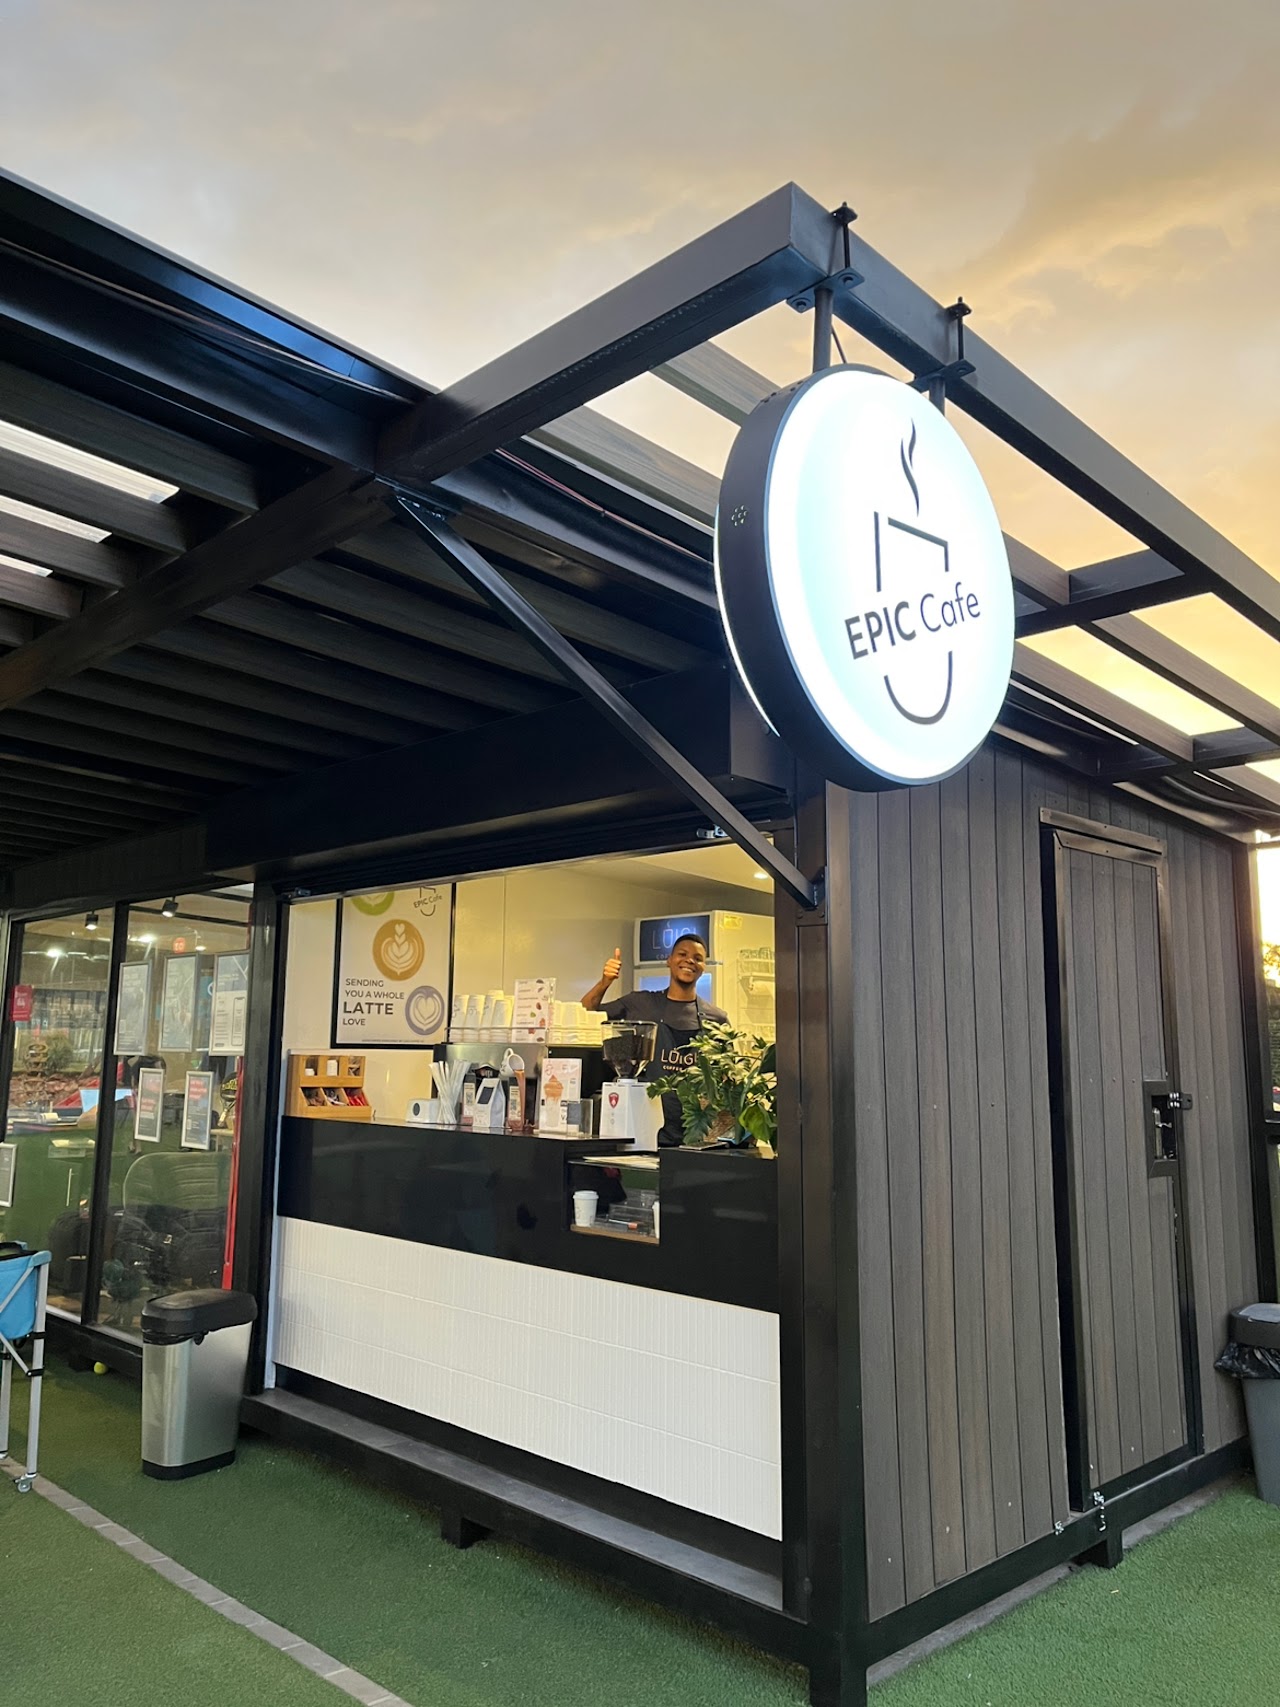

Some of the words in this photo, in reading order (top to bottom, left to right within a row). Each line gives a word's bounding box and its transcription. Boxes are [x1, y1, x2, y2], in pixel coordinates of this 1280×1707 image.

[844, 600, 917, 660] EPIC
[920, 581, 981, 633] Cafe
[413, 898, 429, 908] EPIC
[429, 894, 443, 903] Cafe
[345, 978, 384, 988] SENDING
[345, 989, 364, 998] YOU
[365, 990, 372, 998] A
[373, 991, 405, 1000] WHOLE
[343, 1001, 394, 1015] LATTE
[342, 1018, 366, 1026] LOVE
